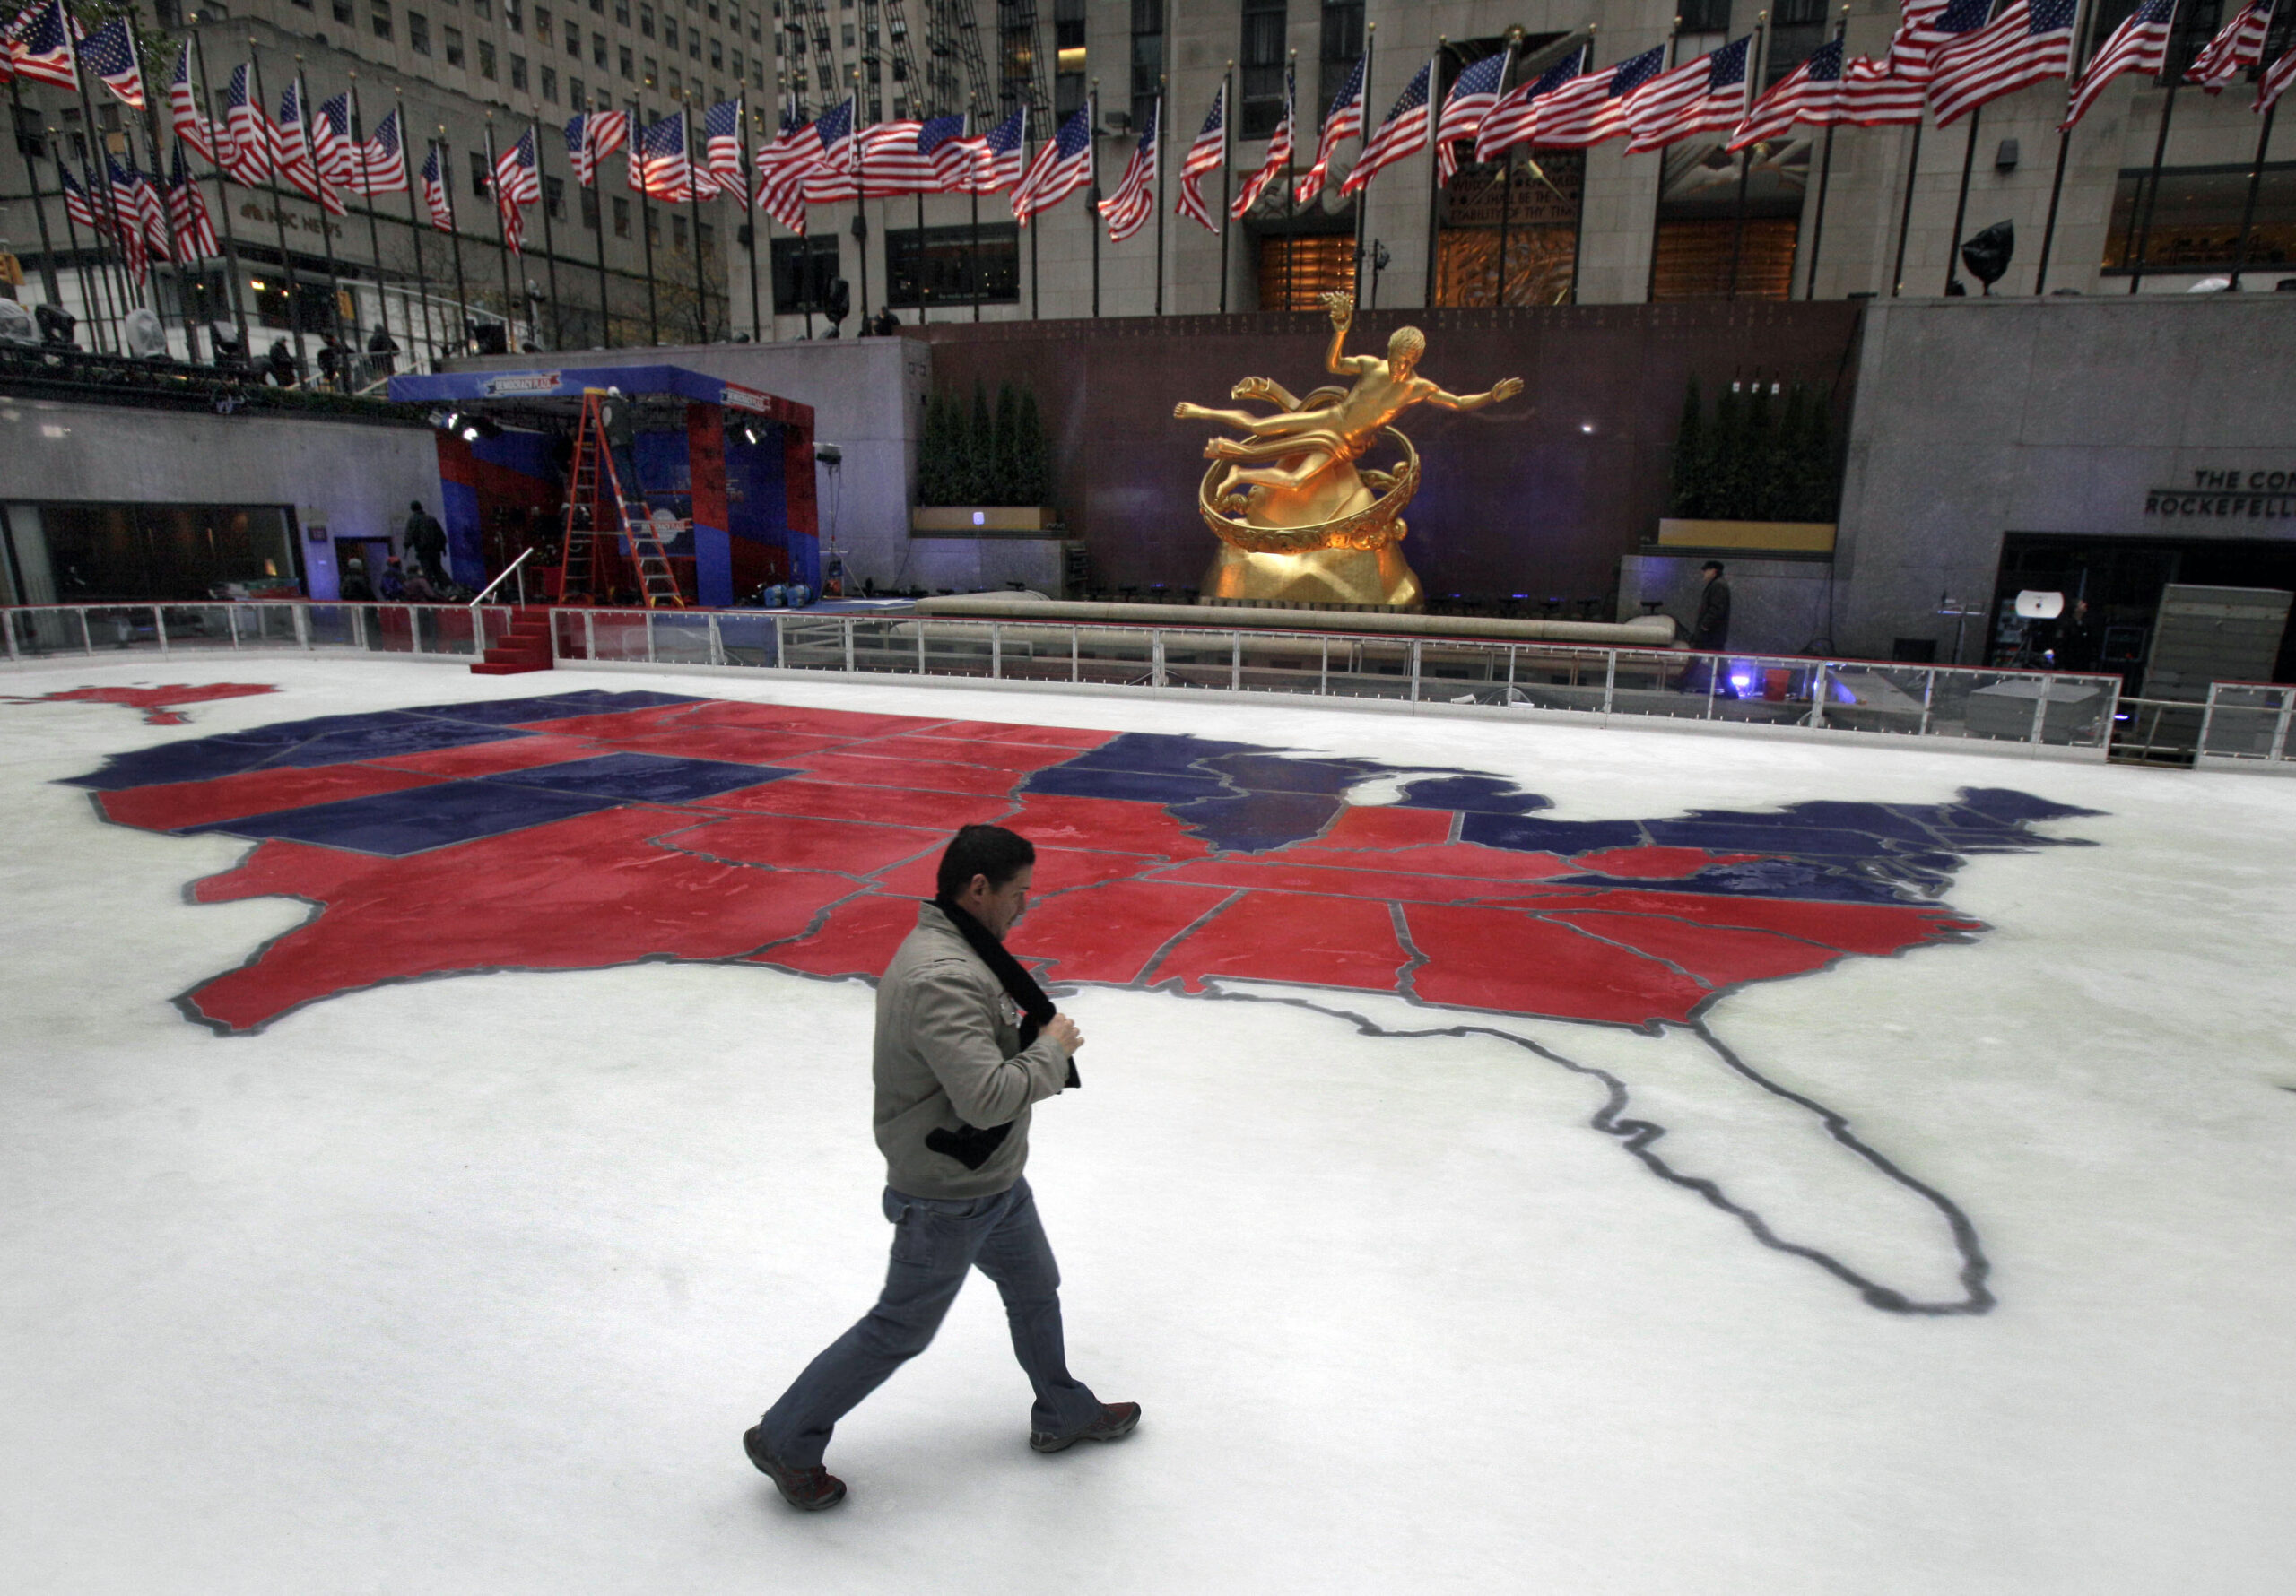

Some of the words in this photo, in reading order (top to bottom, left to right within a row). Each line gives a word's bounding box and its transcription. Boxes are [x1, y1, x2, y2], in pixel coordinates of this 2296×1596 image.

[267, 207, 299, 230] NBC
[301, 215, 343, 239] NEWS
[495, 379, 532, 391] DEMOCRACY
[533, 377, 552, 389] PLAZA
[2195, 471, 2240, 488] THE
[2145, 497, 2296, 517] ROCKEFELL
